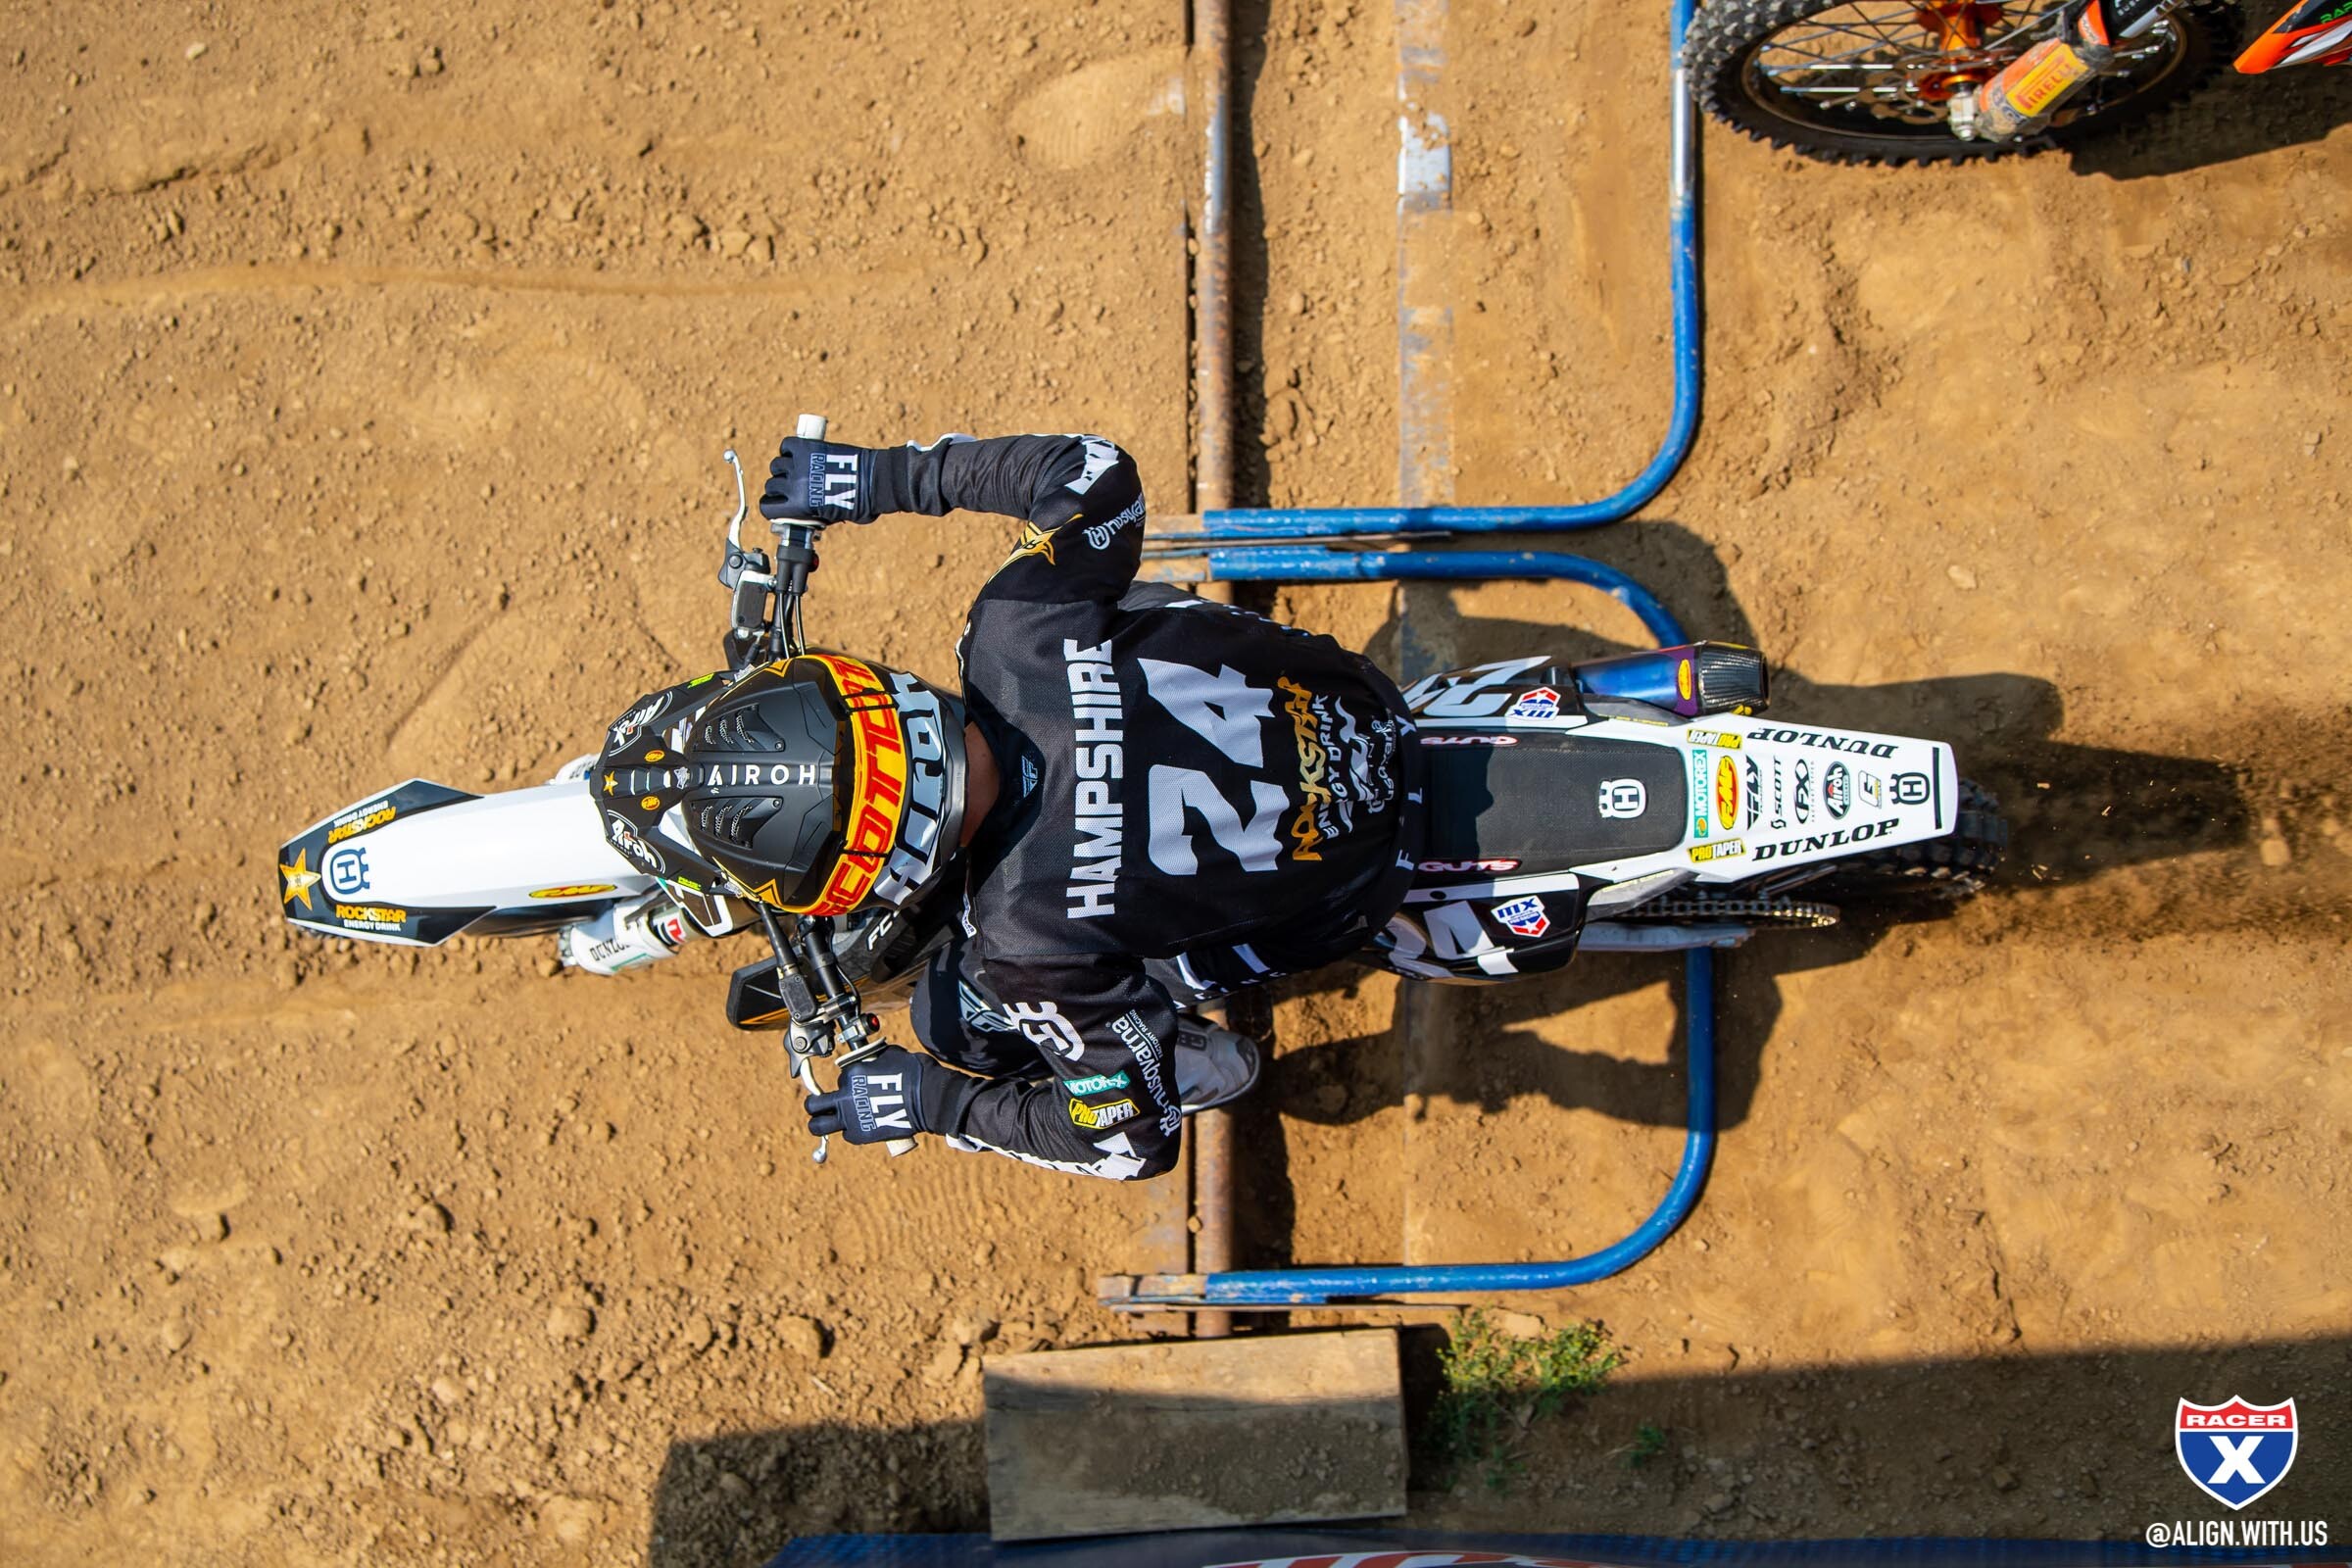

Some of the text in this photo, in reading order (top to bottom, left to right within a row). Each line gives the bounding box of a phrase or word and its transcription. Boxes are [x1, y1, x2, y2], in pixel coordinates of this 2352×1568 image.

[808, 453, 826, 508] RACING
[824, 454, 858, 511] FLY
[1312, 694, 1342, 761] DRINK
[1746, 727, 1899, 759] DUNLOP
[708, 763, 816, 789] AIROH
[1063, 638, 1125, 919] HAMPSHIRE
[1137, 657, 1291, 876] 24
[1694, 752, 1708, 816] MOTOREX
[1745, 755, 1759, 821] FLY
[1773, 756, 1783, 817] SCOTT
[1827, 766, 1843, 815] Airoh
[1717, 756, 1739, 830] FMF
[328, 807, 397, 844] ROCKSTAR
[1691, 841, 1743, 861] PROTAPER
[1751, 817, 1899, 861] DUNLOP
[1419, 860, 1518, 872] GUTS
[335, 905, 407, 924] ROCKSTAR
[343, 919, 402, 932] ENERGY DRINK
[1128, 1009, 1149, 1033] RACING
[851, 1074, 878, 1132] RACING
[866, 1072, 911, 1132] FLY
[1071, 1102, 1135, 1128] PROTAPER
